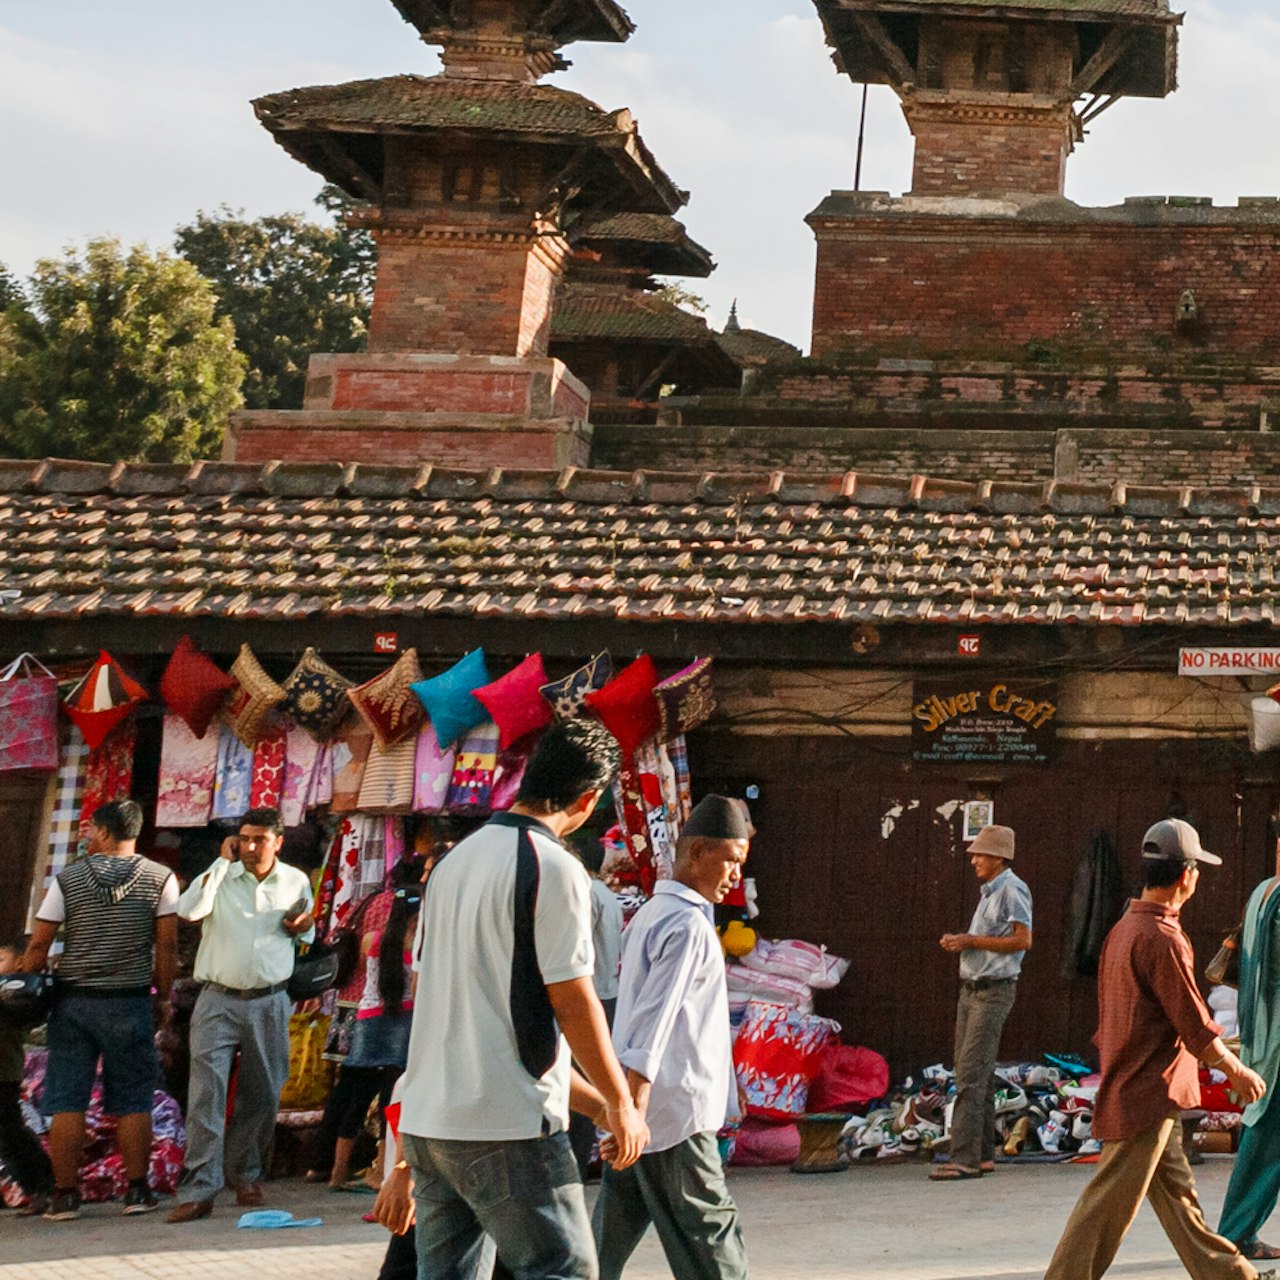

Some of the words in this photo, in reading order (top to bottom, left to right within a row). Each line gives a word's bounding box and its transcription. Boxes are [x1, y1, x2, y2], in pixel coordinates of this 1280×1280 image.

[1182, 652, 1204, 667] NO
[913, 691, 980, 732] Silver
[989, 684, 1056, 729] Craft
